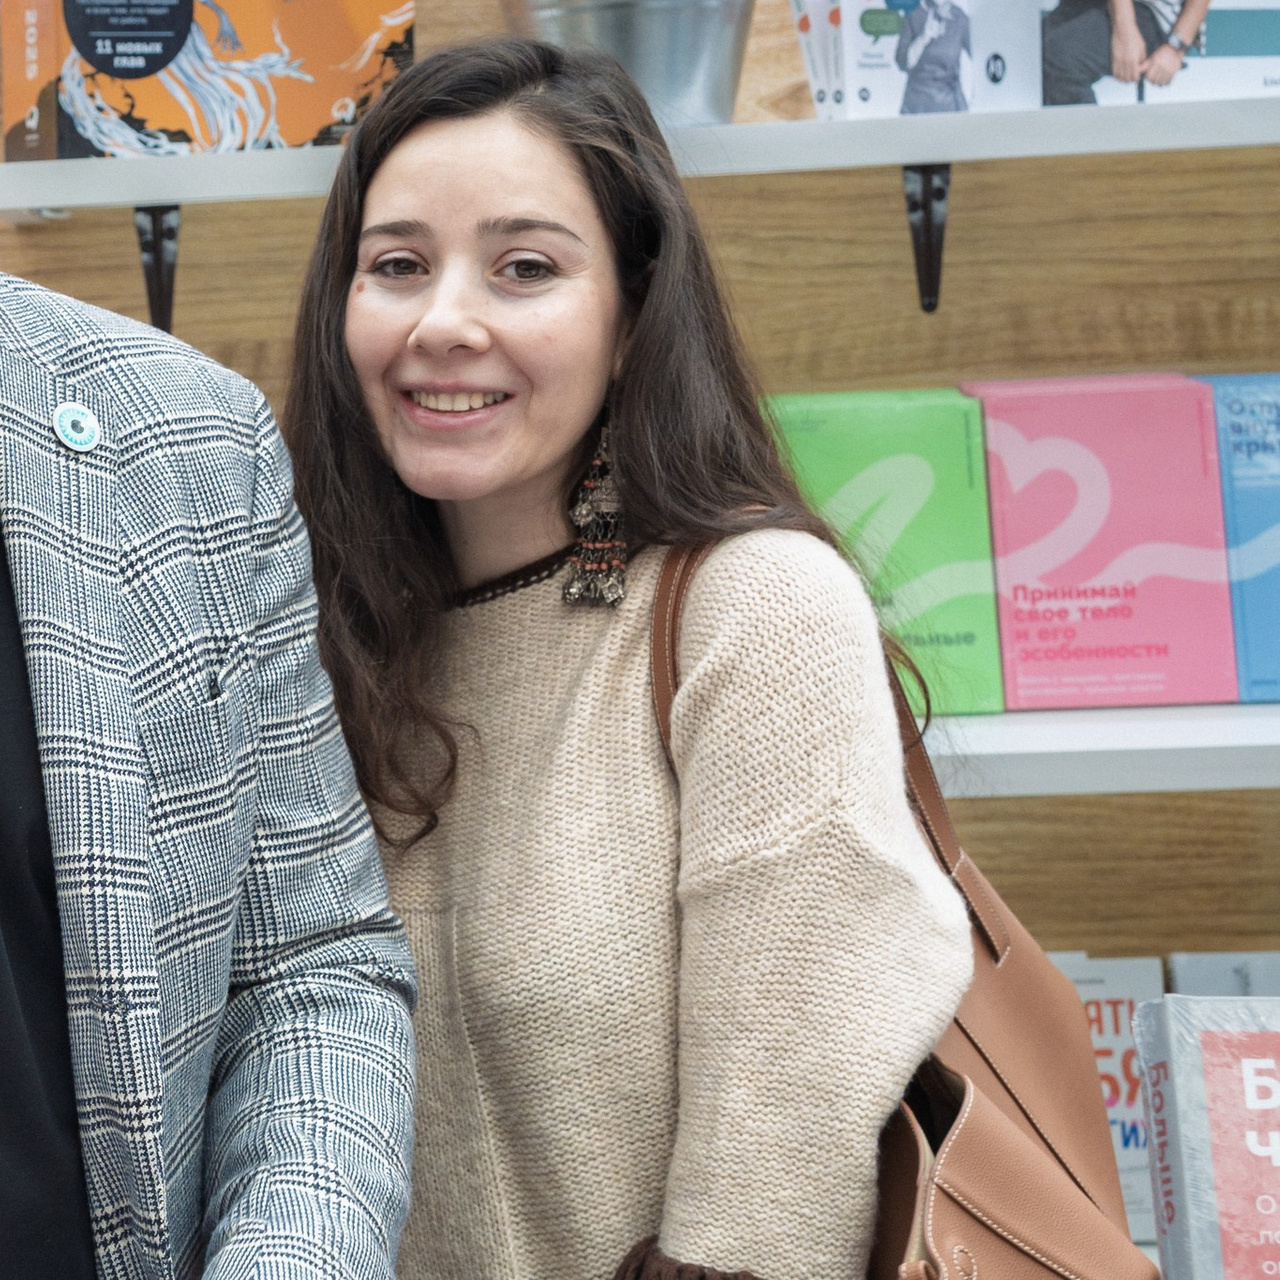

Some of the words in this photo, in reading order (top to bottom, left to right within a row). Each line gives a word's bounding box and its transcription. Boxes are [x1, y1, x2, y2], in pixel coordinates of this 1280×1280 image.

[95, 38, 114, 55] 11
[1012, 583, 1138, 606] Принимай
[1148, 1059, 1177, 1236] Больше,
